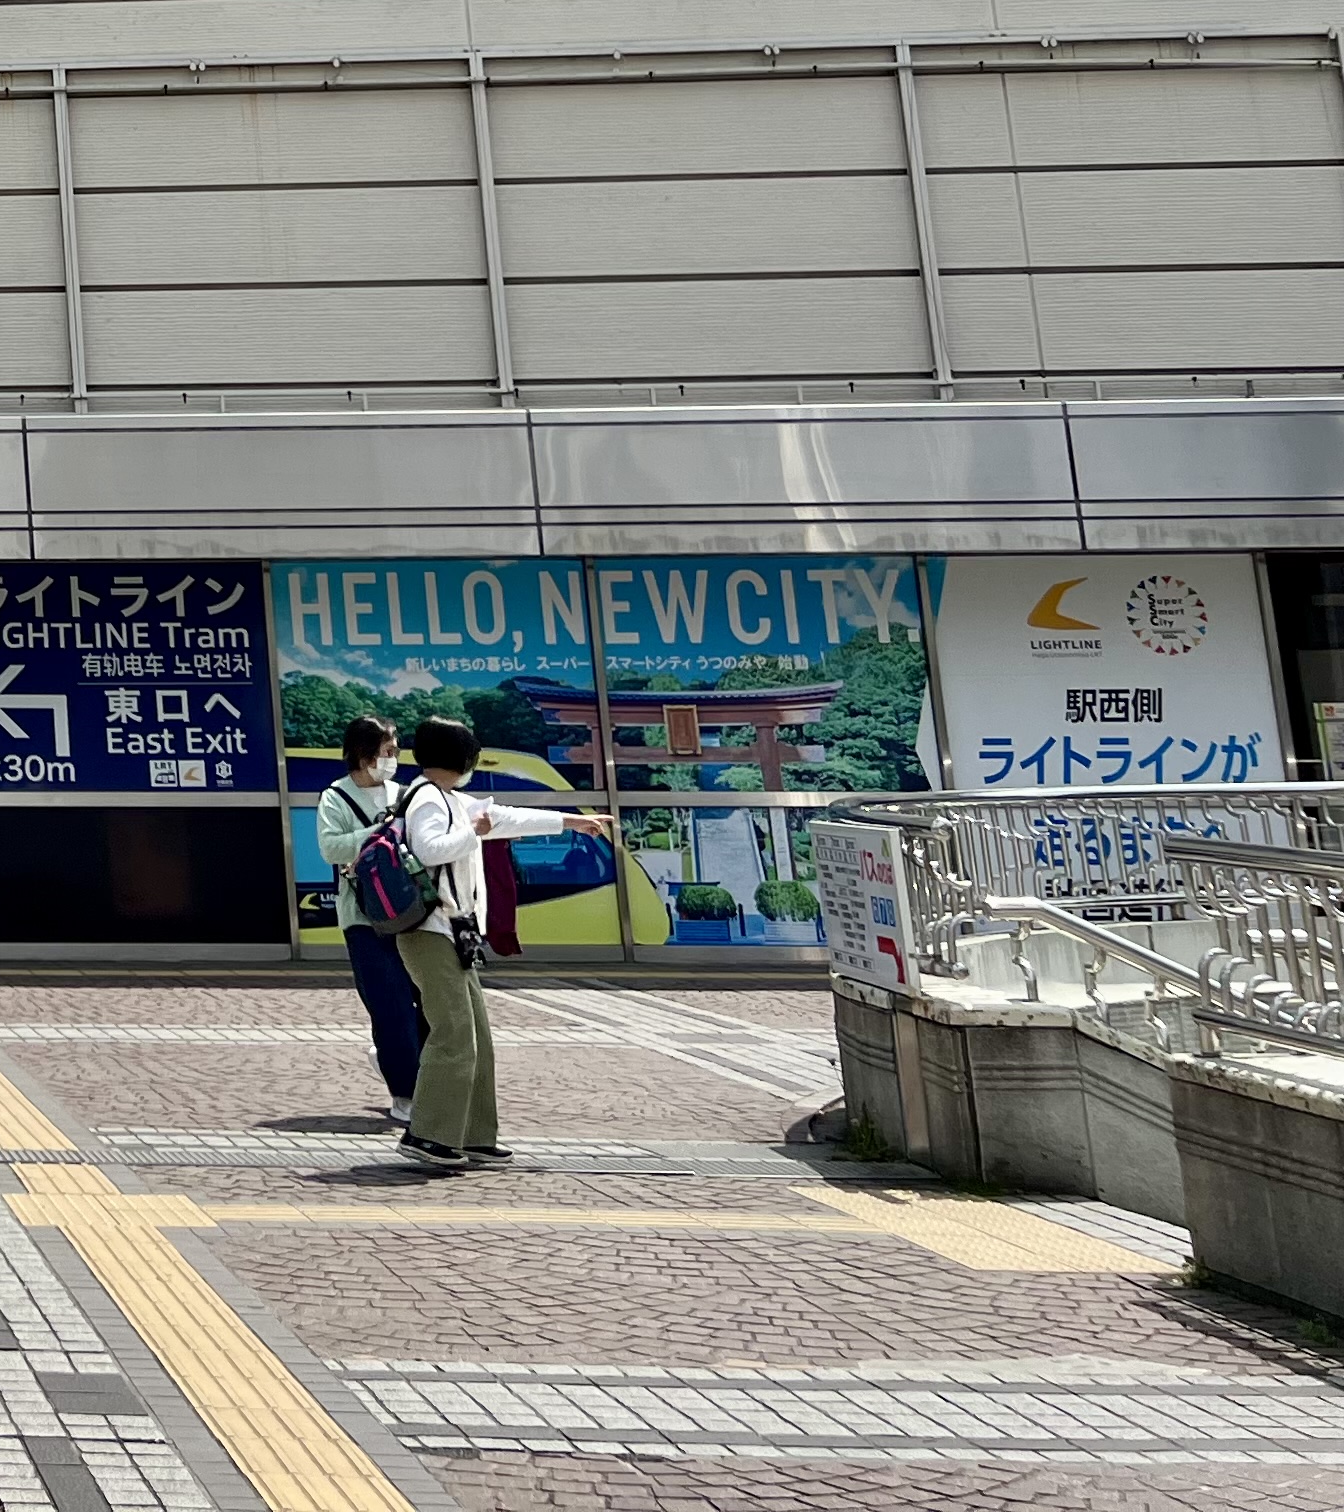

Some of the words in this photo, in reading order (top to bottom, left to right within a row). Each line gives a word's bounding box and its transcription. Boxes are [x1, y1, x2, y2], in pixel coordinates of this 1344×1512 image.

[288, 569, 524, 653] HELLO,
[541, 568, 708, 648] NEW
[726, 568, 922, 645] CITY.
[162, 622, 250, 650] Tram
[1030, 640, 1103, 650] LIGHTLINE
[81, 653, 165, 678] 有轨电车
[173, 653, 253, 679] 노면전차
[104, 687, 243, 725] 東口へ
[1064, 687, 1164, 724] 駅西側
[107, 727, 176, 755] East
[186, 726, 249, 755] Exit
[978, 732, 1262, 785] ライトラインが
